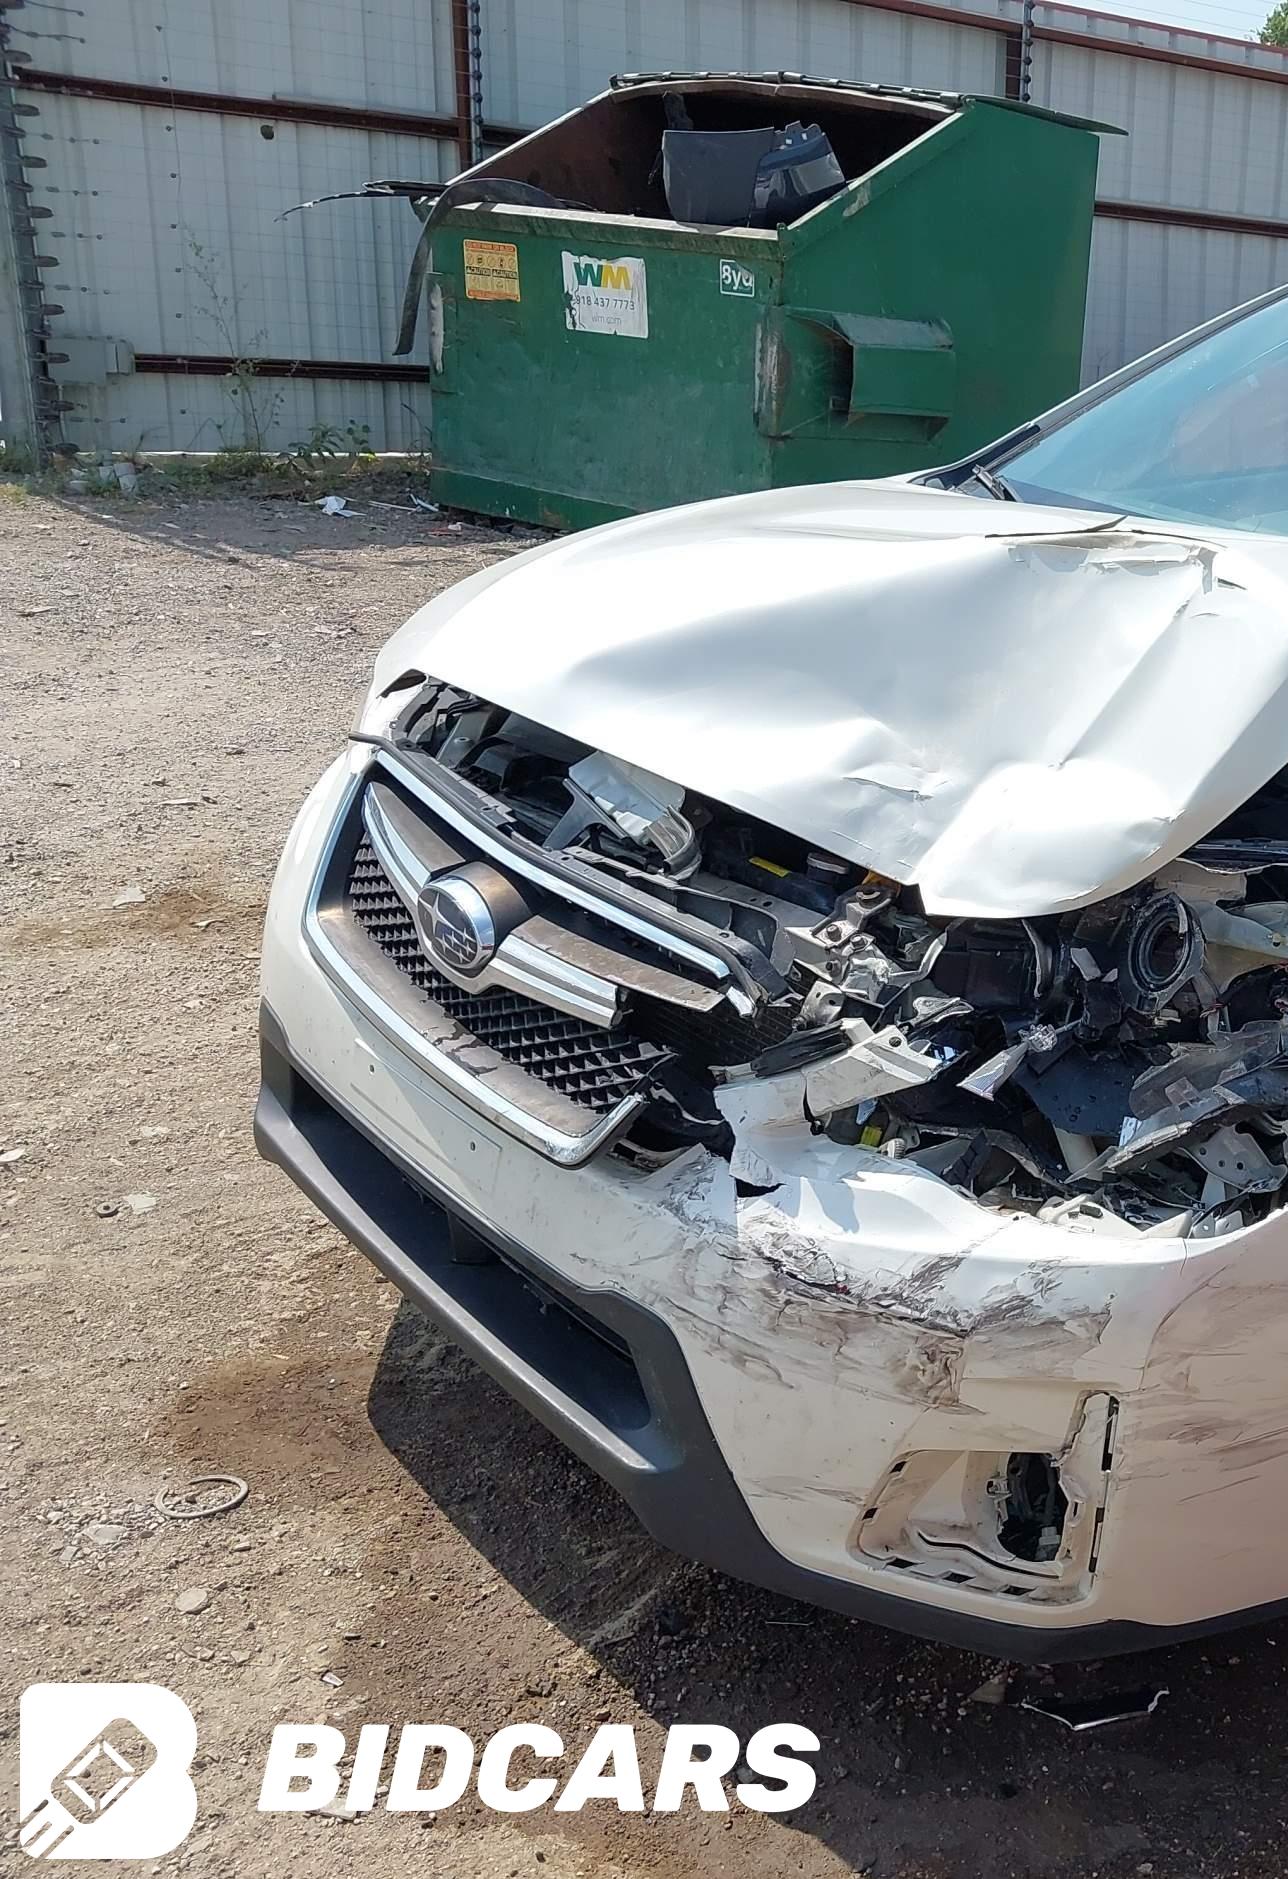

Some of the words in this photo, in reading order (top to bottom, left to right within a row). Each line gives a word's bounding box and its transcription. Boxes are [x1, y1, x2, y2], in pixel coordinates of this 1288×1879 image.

[573, 262, 633, 290] WM
[576, 295, 592, 306] 918
[593, 297, 610, 308] 437
[613, 299, 635, 311] 7773
